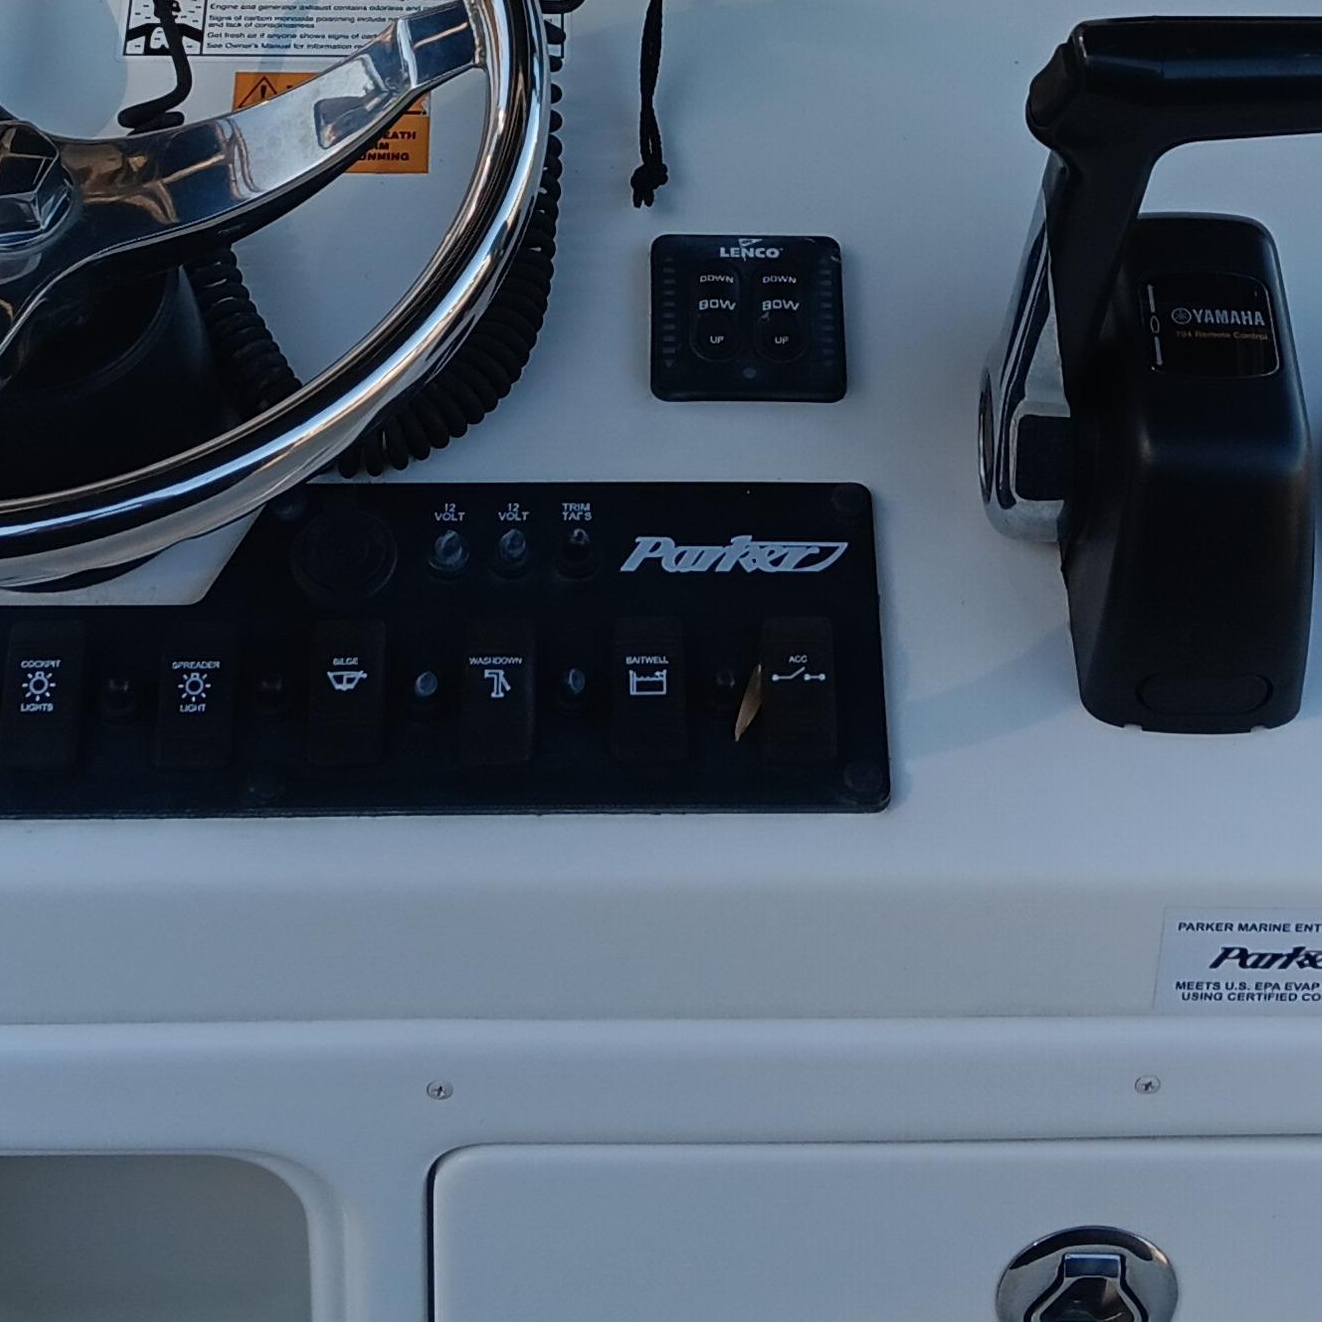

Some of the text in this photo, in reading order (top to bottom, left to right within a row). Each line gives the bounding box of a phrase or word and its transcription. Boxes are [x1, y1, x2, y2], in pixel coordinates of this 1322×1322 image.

[719, 246, 780, 259] LENCO
[699, 274, 734, 284] DOWN
[762, 275, 797, 284] DOWN
[698, 299, 736, 311] BOW
[762, 299, 800, 311] BOW
[1191, 308, 1265, 326] YAMAHA
[709, 335, 724, 344] UP
[774, 335, 789, 345] UP
[1233, 331, 1269, 340] Control
[444, 503, 456, 512] 12
[508, 502, 520, 512] 12
[561, 502, 591, 512] TRIM
[434, 512, 466, 521] VOLT
[498, 511, 530, 521] VOLT
[620, 535, 848, 573] Parker
[20, 659, 62, 669] COCKPIT
[332, 657, 359, 666] BILGE
[469, 656, 523, 666] WASHDOWN
[625, 656, 669, 665] BAITWELL
[788, 655, 808, 664] ACC
[172, 660, 221, 670] SPREADER
[20, 703, 54, 712] LIGHTS
[179, 703, 207, 712] LIGHT
[1178, 922, 1234, 933] PARKER
[1237, 922, 1291, 933] MARINE
[1175, 980, 1221, 991] MEETS
[1225, 981, 1251, 991] U.S.
[1254, 981, 1281, 991] EPA
[1284, 981, 1321, 992] EVAP
[1181, 991, 1223, 1002] USING
[1227, 992, 1298, 1002] CERTIFIED
